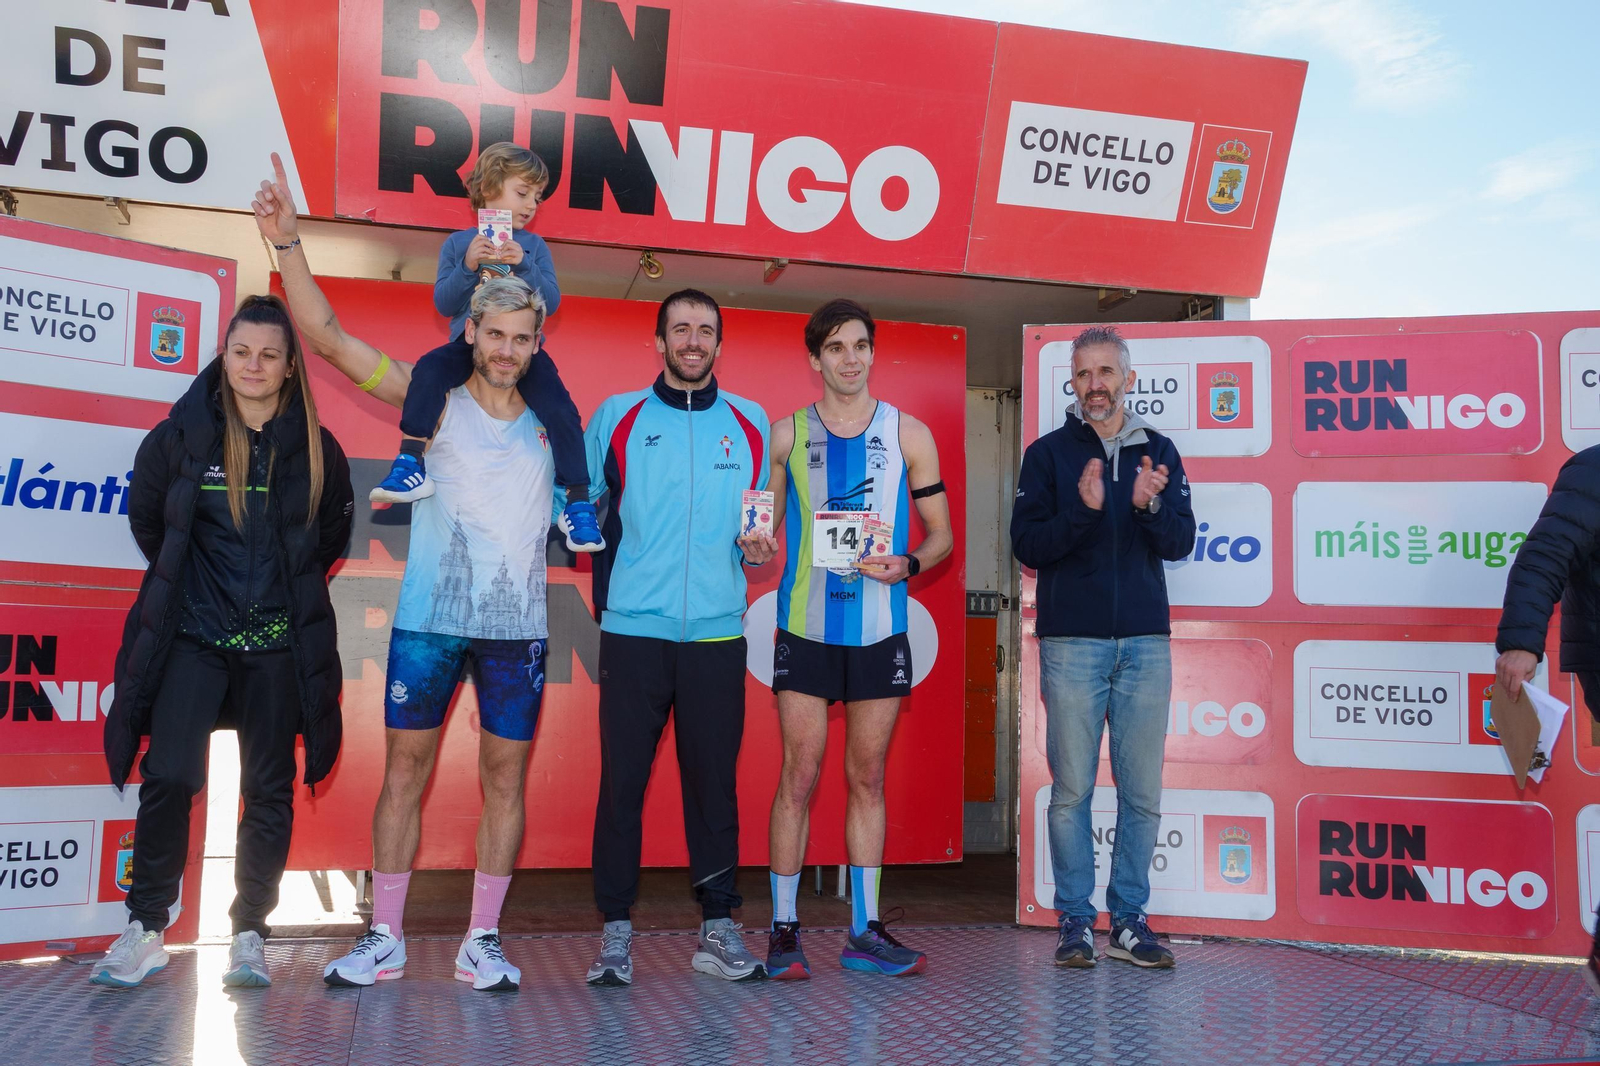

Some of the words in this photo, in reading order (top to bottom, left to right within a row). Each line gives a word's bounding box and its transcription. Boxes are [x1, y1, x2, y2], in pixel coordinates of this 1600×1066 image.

[54, 26, 166, 96] DE
[380, 0, 670, 107] RUN
[1020, 126, 1175, 165] CONCELLO
[1033, 160, 1072, 187] DE
[1084, 165, 1151, 195] VIGO
[0, 286, 114, 321] NCELLO
[3, 311, 19, 332] E
[30, 315, 96, 343] VIGO
[1304, 358, 1407, 394] RUN
[1124, 399, 1164, 415] IGO
[0, 458, 134, 516] lánti
[826, 527, 859, 549] 14
[1182, 522, 1261, 562] ico
[1315, 521, 1400, 559] máis
[1408, 525, 1433, 565] que
[830, 591, 856, 600] MGM
[1320, 683, 1448, 704] CONCELLO
[1336, 706, 1366, 724] DE
[1375, 708, 1433, 726] VIGO
[0, 839, 78, 862] ELLO
[1319, 819, 1426, 861] RUN
